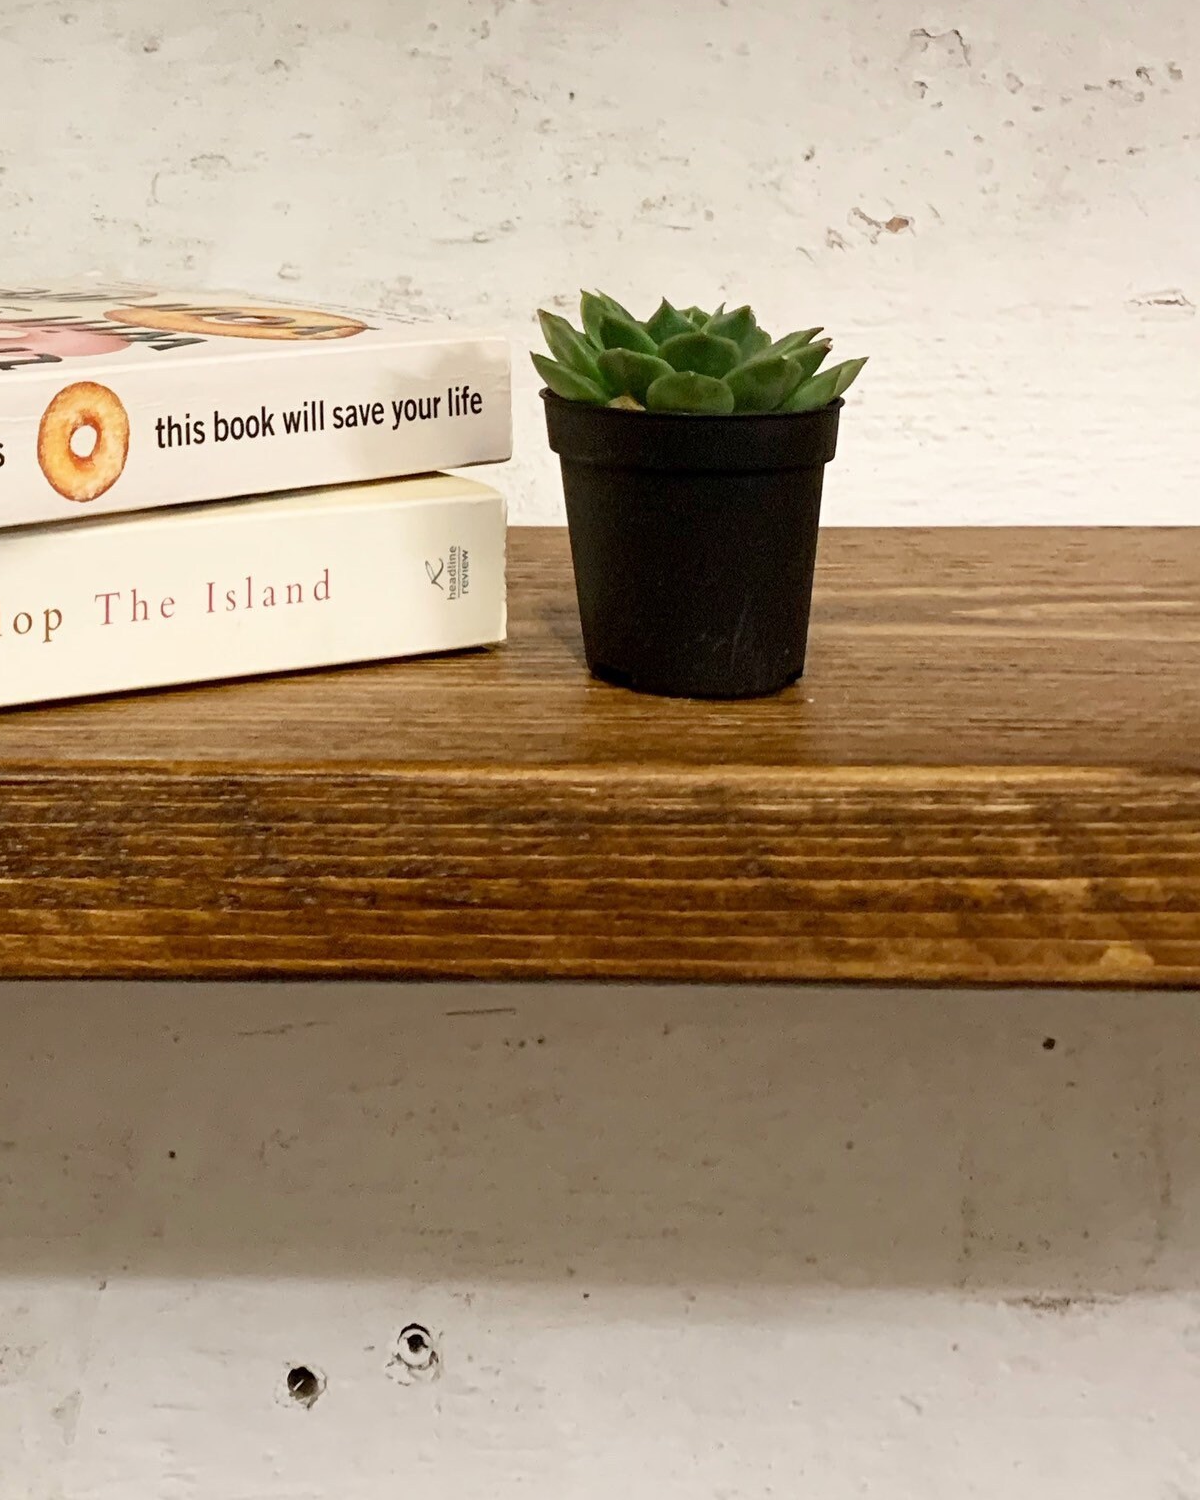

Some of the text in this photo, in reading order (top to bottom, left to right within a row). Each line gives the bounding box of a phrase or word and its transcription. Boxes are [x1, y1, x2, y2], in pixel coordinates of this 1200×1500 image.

[154, 384, 484, 449] this book will save your life
[94, 588, 177, 626] The
[206, 567, 332, 614] Island
[446, 545, 458, 601] headline
[461, 549, 470, 595] review
